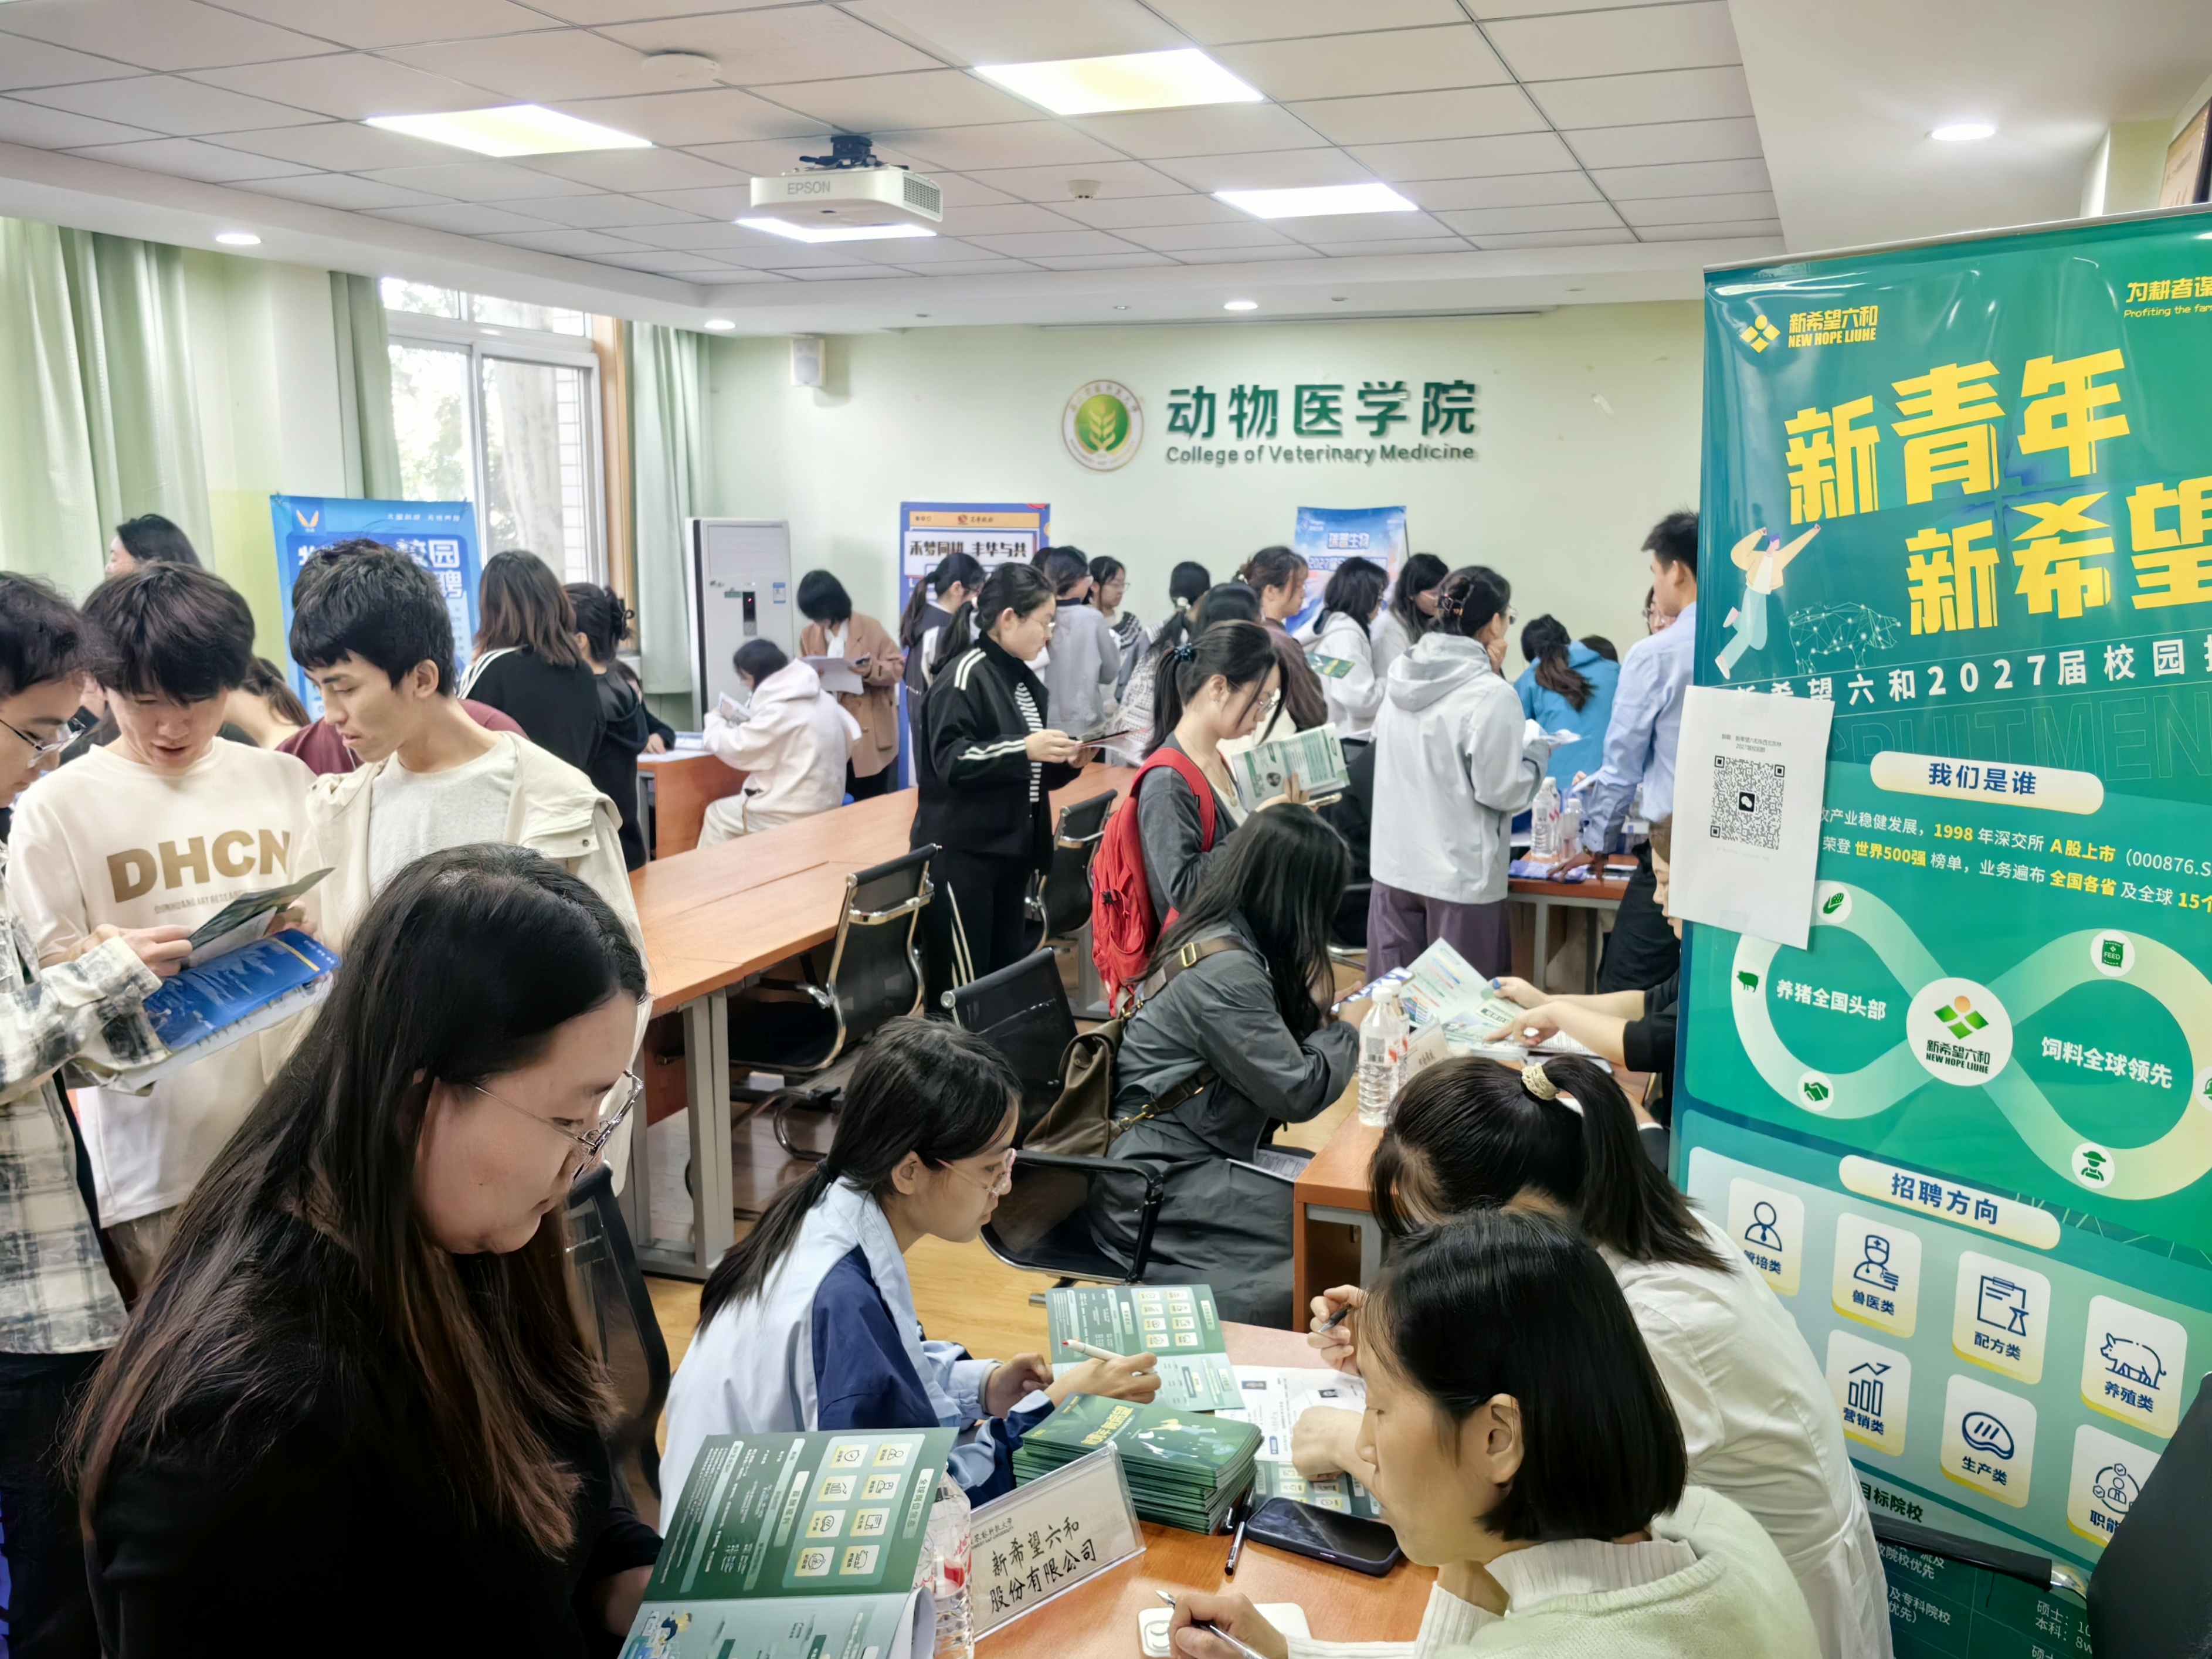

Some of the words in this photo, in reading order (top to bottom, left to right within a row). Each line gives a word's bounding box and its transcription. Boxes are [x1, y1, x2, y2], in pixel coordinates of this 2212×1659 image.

[788, 181, 831, 195] EPSON
[1789, 305, 1878, 334] 新希望六和
[2123, 307, 2172, 318] Profiting
[2174, 305, 2191, 314] the
[1788, 334, 1813, 348] NEW
[1814, 330, 1843, 346] HOPE
[1844, 327, 1877, 343] LIUHE
[1167, 380, 1475, 438] 动物医学院
[1784, 348, 2130, 525] 新青年
[1166, 446, 1239, 464] College
[1245, 445, 1265, 462] of
[1268, 444, 1376, 463] Veterinary
[1380, 443, 1475, 459] Medicine
[1905, 475, 2212, 636] 新希望
[1928, 762, 2036, 796] 我们是谁
[1933, 823, 1974, 842] 1998
[1977, 827, 2044, 852] 年深交所
[2050, 838, 2116, 863] A股上市
[106, 829, 291, 904] DHCN
[1823, 835, 1851, 854] 荣登
[1855, 840, 1927, 867] 世界500强
[2050, 869, 2116, 897] 全国各省
[2120, 881, 2173, 905] 及全球
[2104, 951, 2121, 961] FEED
[1776, 979, 1887, 1021] 养猪全国头部
[1926, 1039, 1991, 1065] 新希望六和
[1926, 1052, 1944, 1063] NEW
[1945, 1057, 1965, 1068] HOPE
[1966, 1061, 1989, 1074] LIUHE
[2041, 1036, 2173, 1090] 饲料全球领先
[1891, 1173, 1999, 1226] 招聘方向
[1852, 1290, 1895, 1317] 兽医类
[1974, 1331, 2022, 1362] 配方类
[2105, 1380, 2154, 1413] 养殖类
[1843, 1406, 1885, 1436] 营销类
[1962, 1456, 2008, 1487] 生产类
[992, 1516, 1080, 1577] 新希望六和
[989, 1538, 1097, 1614] 股份有限公司
[1889, 1585, 1951, 1626] 及专科院校
